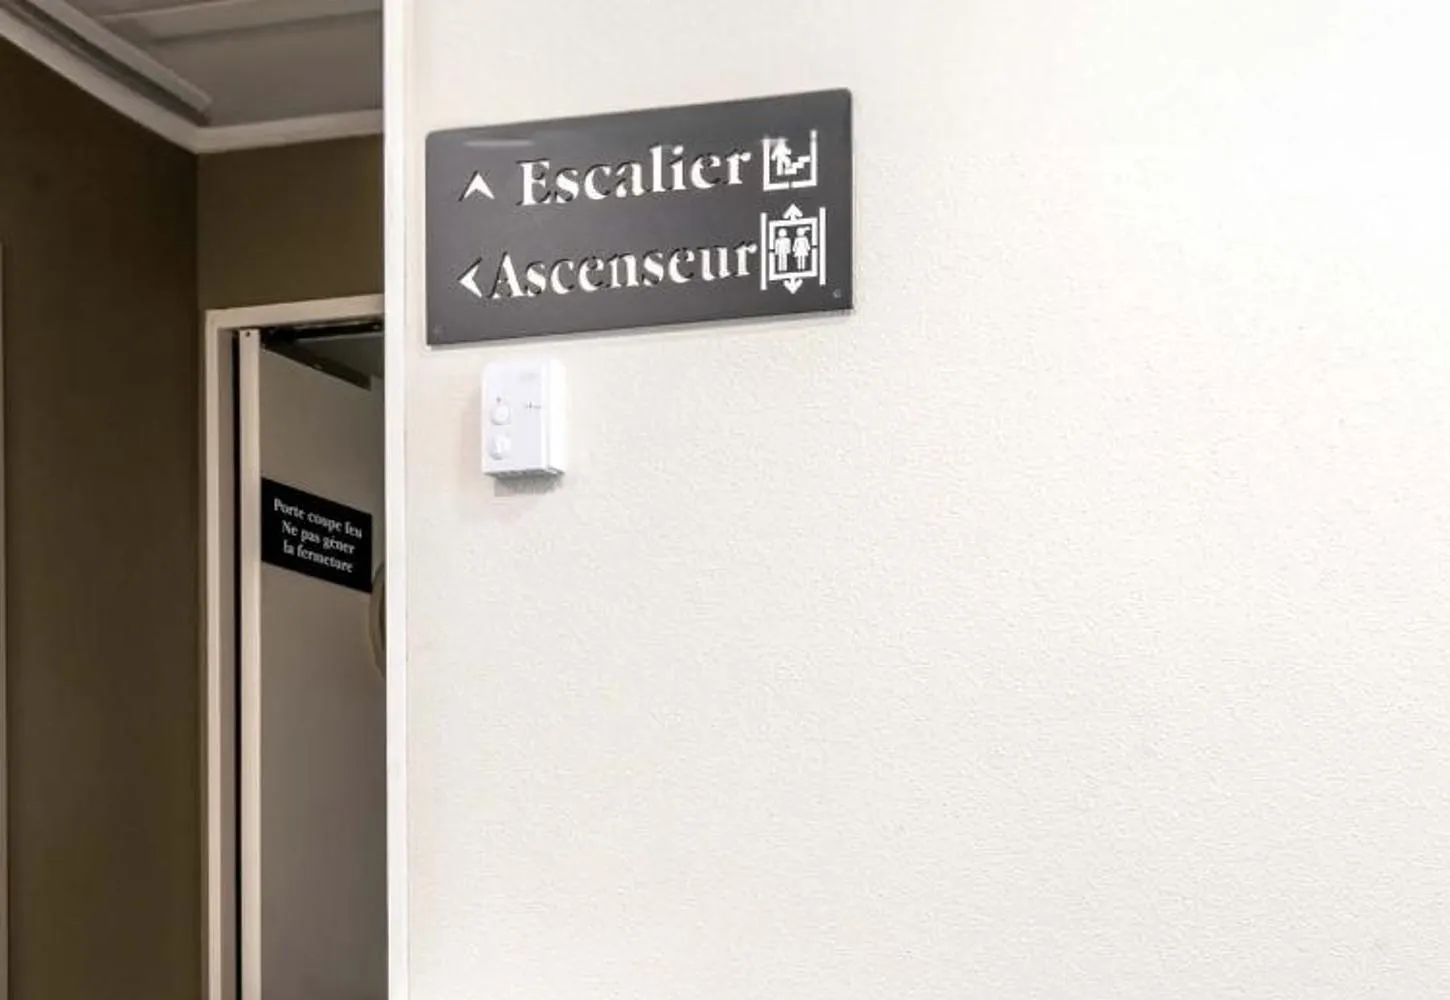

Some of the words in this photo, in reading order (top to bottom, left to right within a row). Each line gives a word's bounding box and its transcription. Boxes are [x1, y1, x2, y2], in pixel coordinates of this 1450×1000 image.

[518, 144, 752, 206] Escalier
[490, 240, 759, 300] Ascenseur
[274, 498, 305, 519] Porte
[307, 512, 342, 532] coupe
[345, 521, 362, 538] feu
[282, 520, 298, 536] Ne
[301, 529, 320, 544] pas
[283, 540, 294, 555] la
[297, 544, 353, 573] fermeture
